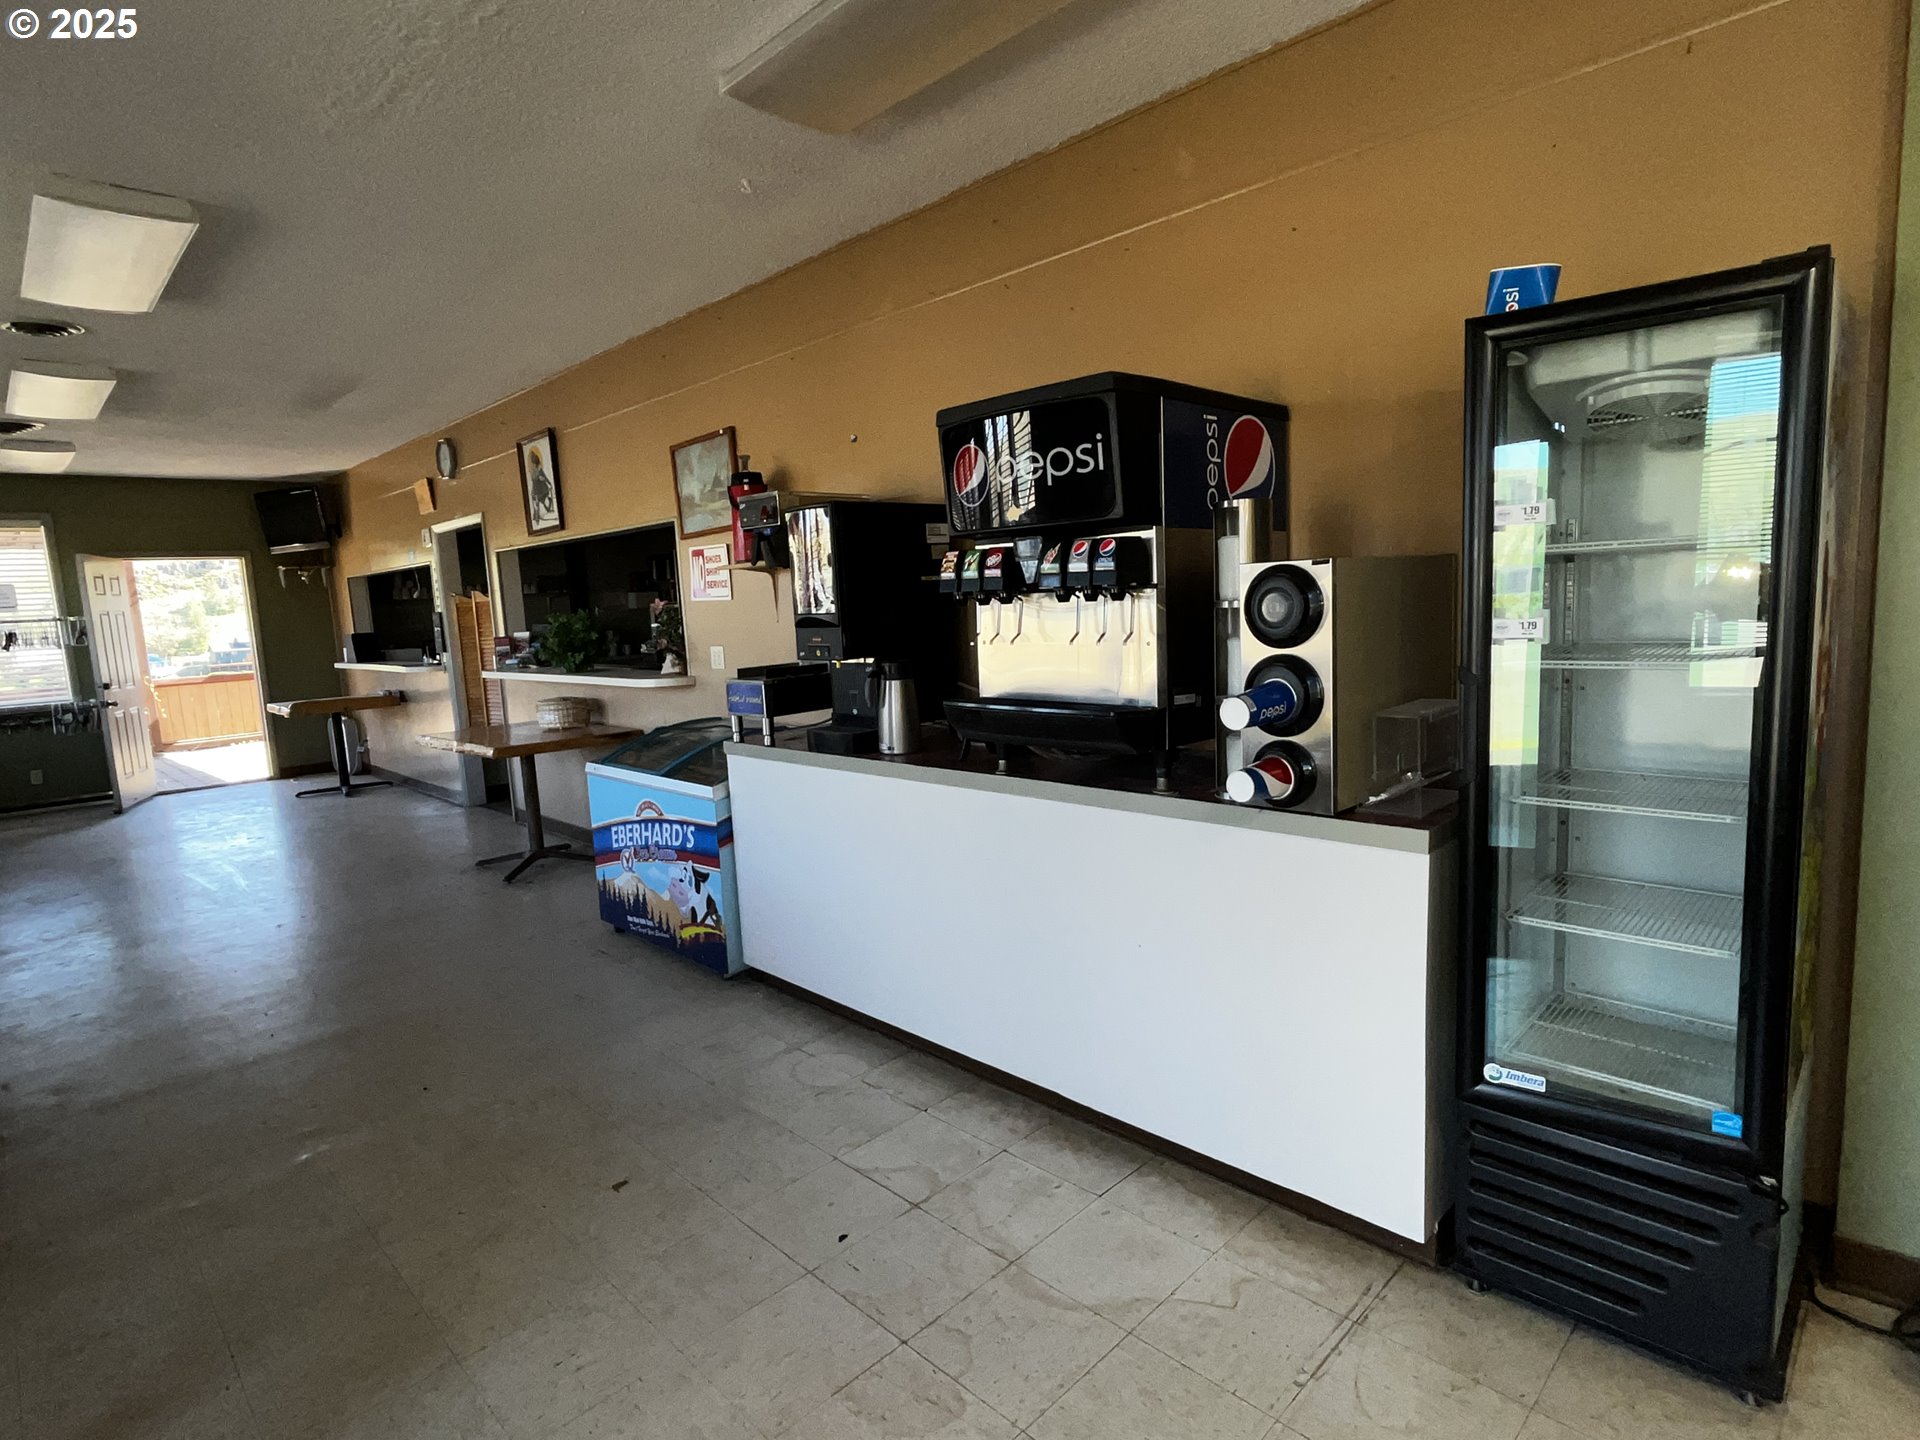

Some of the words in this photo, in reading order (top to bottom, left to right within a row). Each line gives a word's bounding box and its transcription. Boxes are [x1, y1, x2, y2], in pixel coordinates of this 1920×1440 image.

[996, 433, 1104, 493] pepsi
[705, 554, 722, 564] SHOES
[692, 555, 705, 591] NO
[706, 579, 728, 589] SERVICE
[1259, 700, 1287, 721] pepsi
[611, 822, 696, 849] EBERHARD'S
[1504, 1071, 1545, 1088] Imbera
